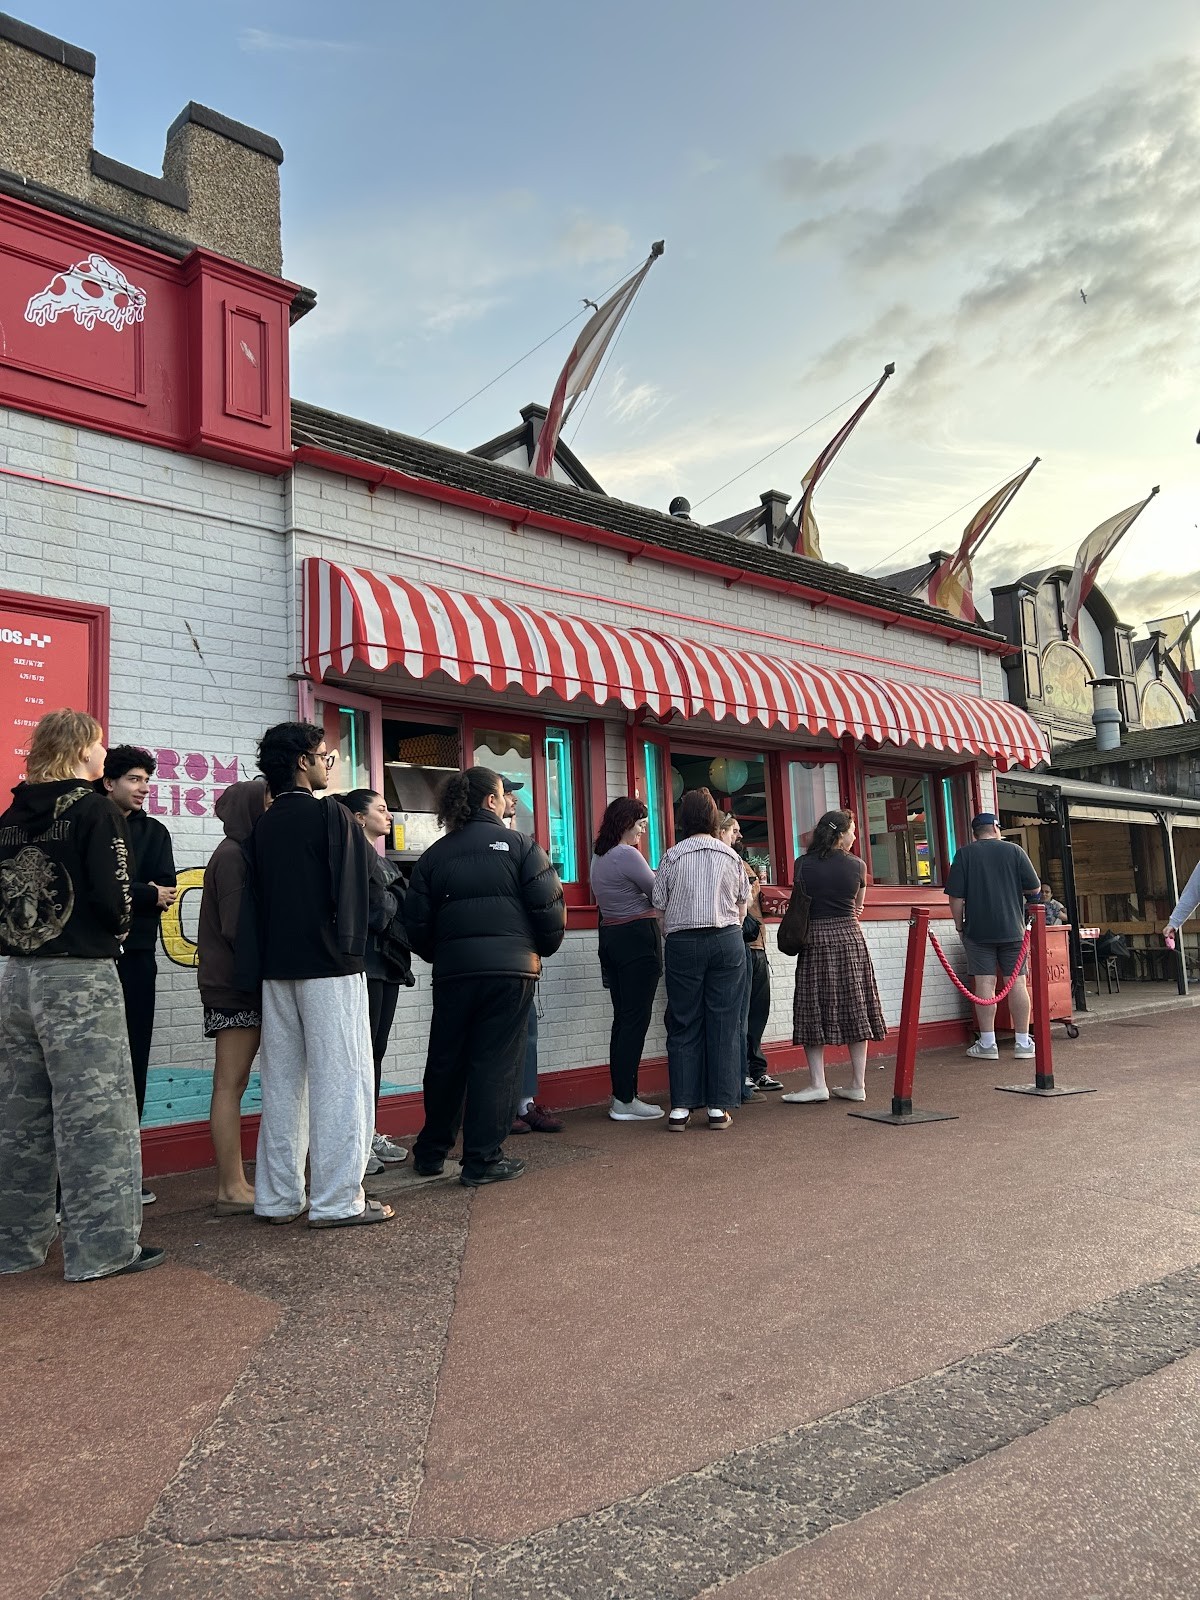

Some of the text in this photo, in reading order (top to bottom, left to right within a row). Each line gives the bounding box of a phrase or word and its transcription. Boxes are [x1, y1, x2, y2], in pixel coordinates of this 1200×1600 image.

[0, 628, 23, 645] OS
[132, 746, 239, 784] ROM
[148, 784, 222, 817] LIC
